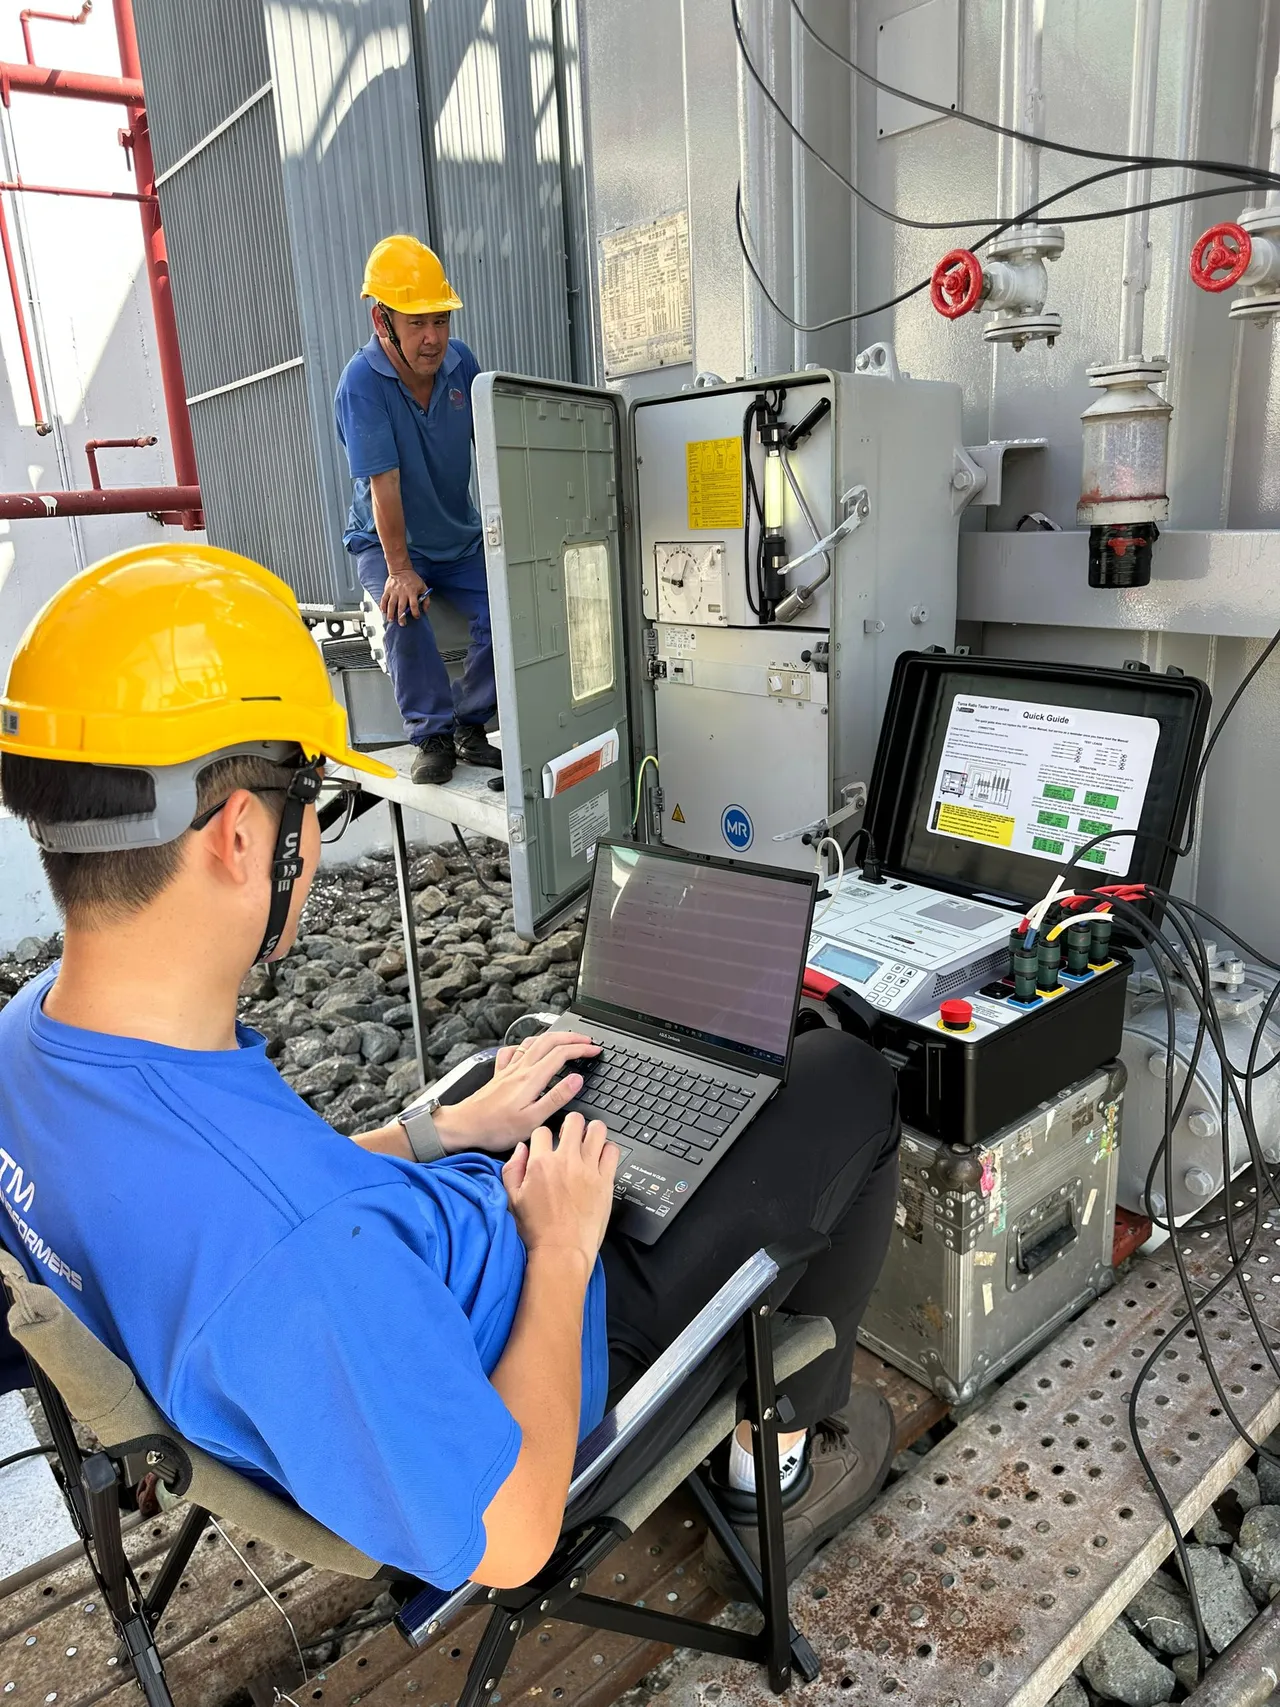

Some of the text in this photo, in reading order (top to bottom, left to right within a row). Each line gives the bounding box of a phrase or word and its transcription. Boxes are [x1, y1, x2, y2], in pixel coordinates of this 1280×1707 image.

[1022, 711, 1070, 724] Quick Guide
[727, 819, 748, 838] MR
[0, 1147, 35, 1213] TM
